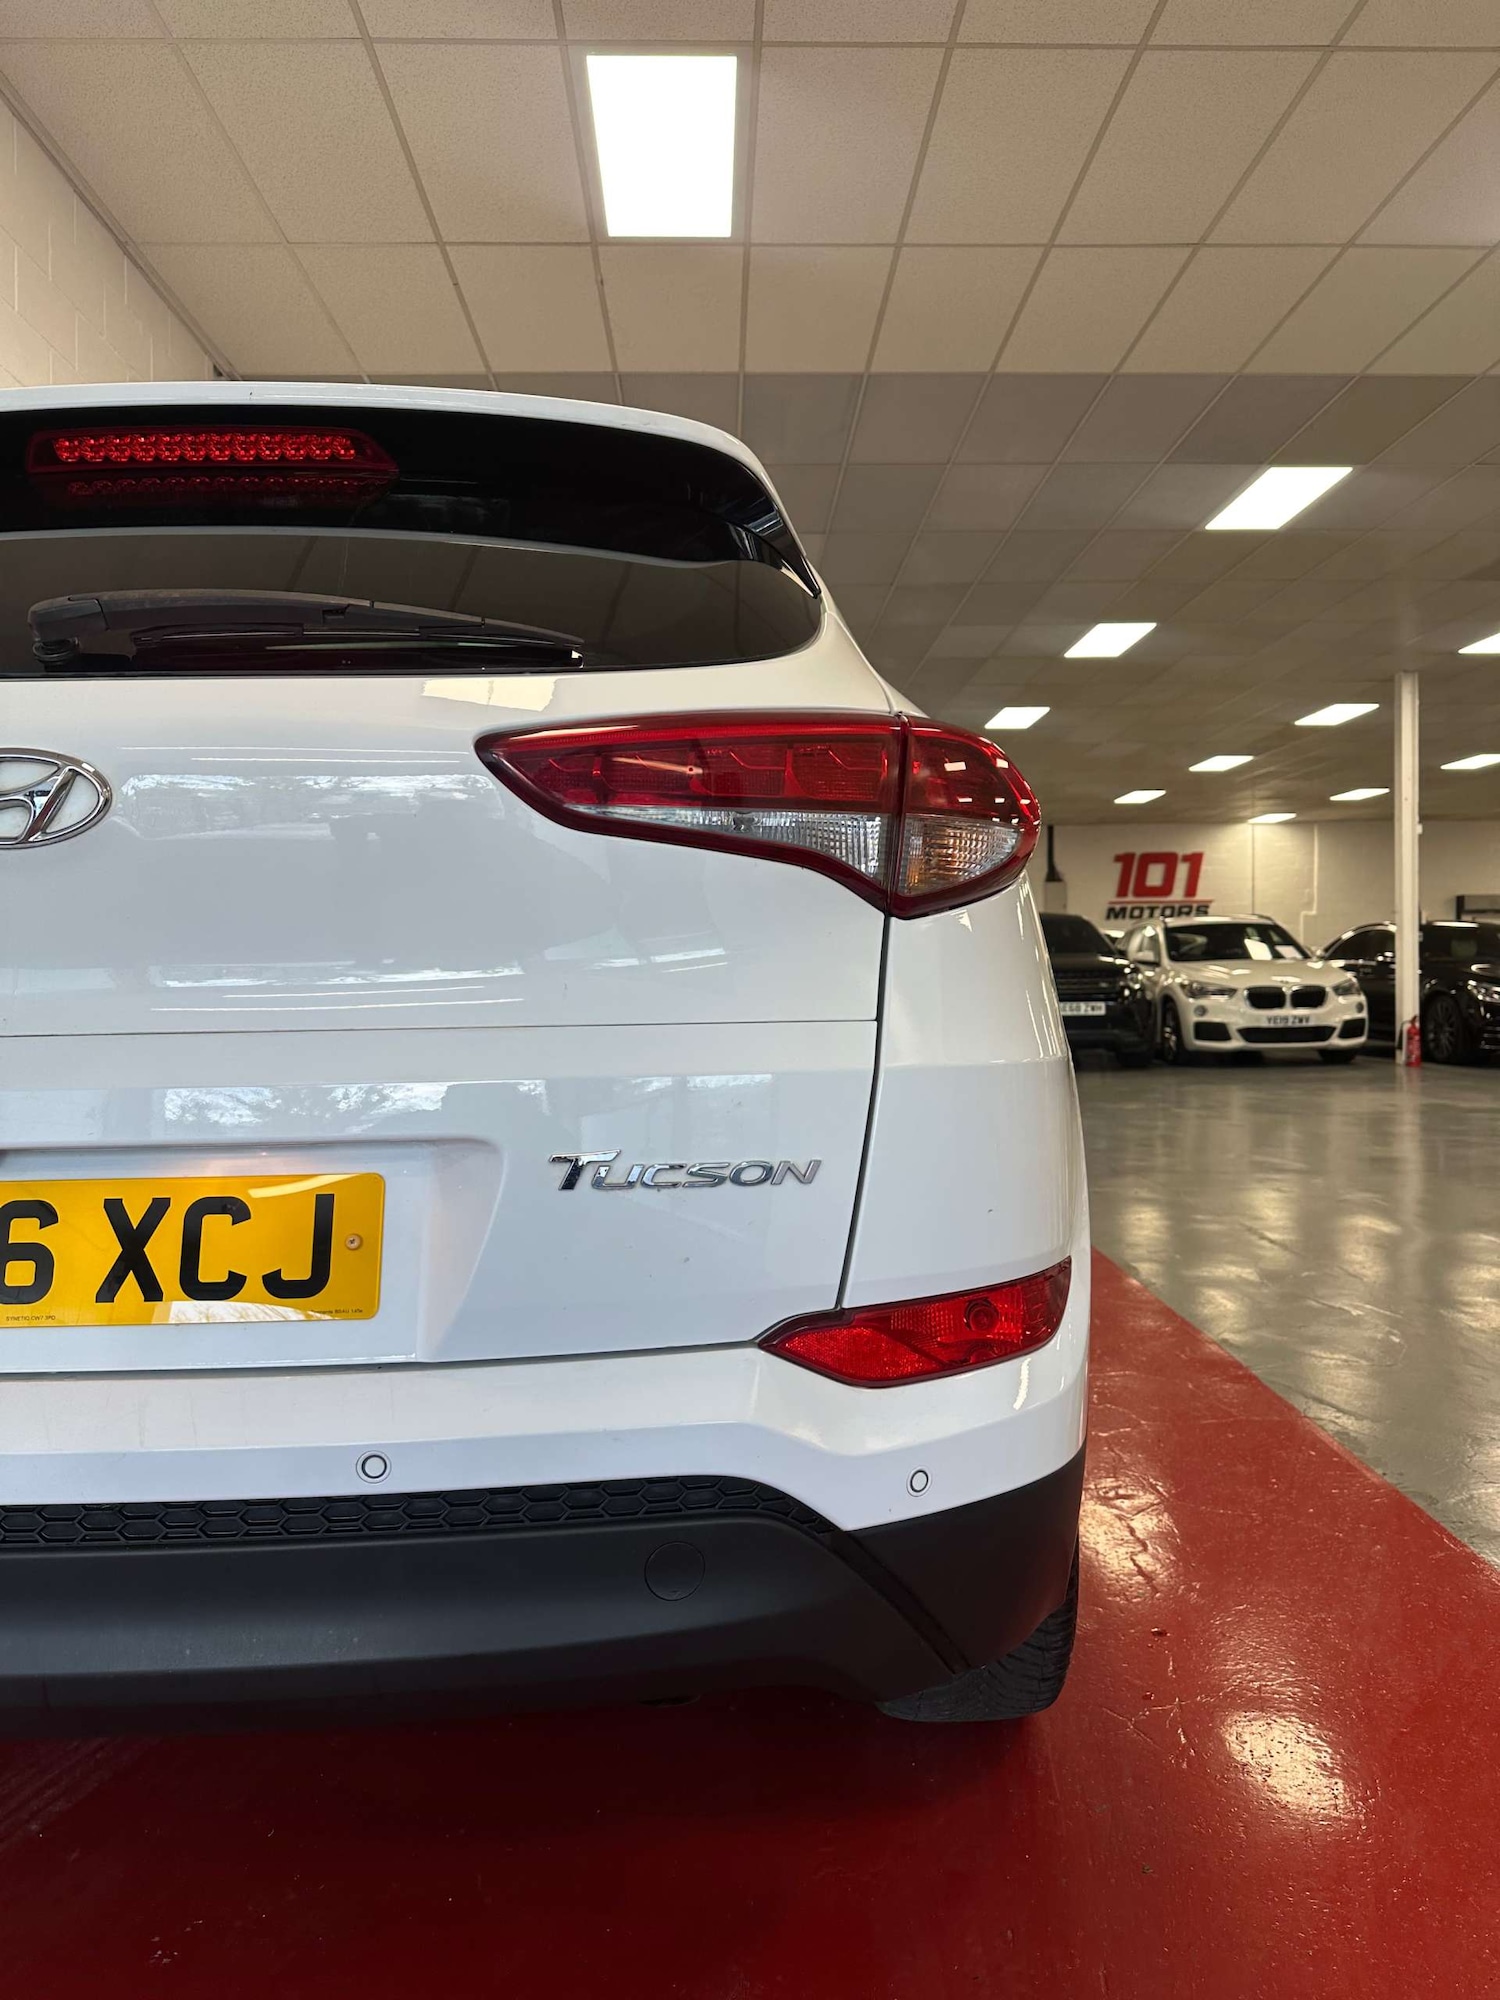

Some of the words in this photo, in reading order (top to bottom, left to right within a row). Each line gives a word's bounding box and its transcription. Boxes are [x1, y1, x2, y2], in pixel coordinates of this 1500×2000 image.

[1114, 851, 1205, 898] 101
[1105, 905, 1209, 921] MOTORS
[549, 1149, 822, 1191] TUCSON
[95, 1194, 335, 1304] XCJ
